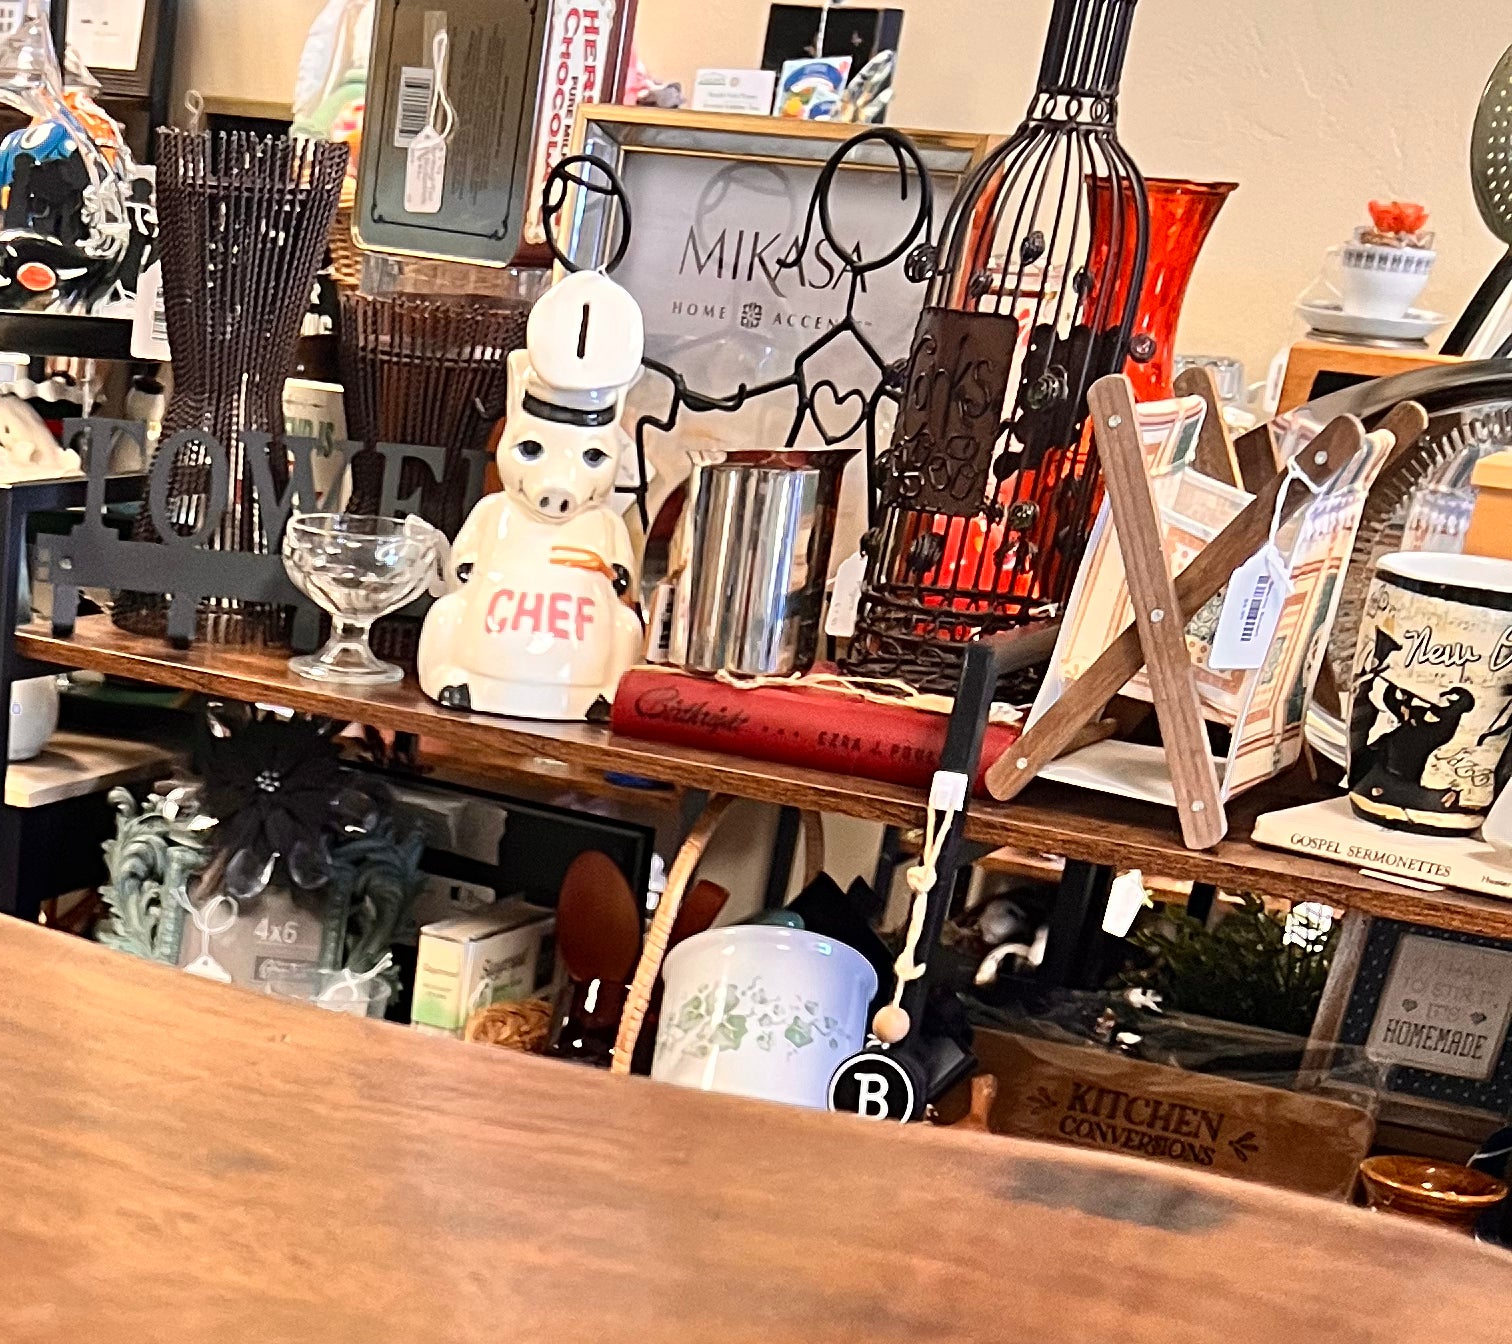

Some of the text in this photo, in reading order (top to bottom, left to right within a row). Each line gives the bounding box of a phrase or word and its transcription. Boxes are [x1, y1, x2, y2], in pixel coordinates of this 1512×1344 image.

[543, 7, 581, 184] CHOCOLA
[565, 75, 579, 119] PURE
[678, 225, 868, 299] MIKASA
[672, 301, 872, 331] HOME ACCEN
[484, 588, 596, 641] CHEF
[1405, 625, 1481, 668] New
[1290, 832, 1452, 878] GOSPEL SERMONETTES
[253, 917, 300, 944] 4x6
[1382, 1018, 1489, 1060] HOMEMADE
[853, 1072, 890, 1120] B
[1066, 1081, 1225, 1142] KITCHEN
[1058, 1114, 1217, 1166] CONVERSIONS
